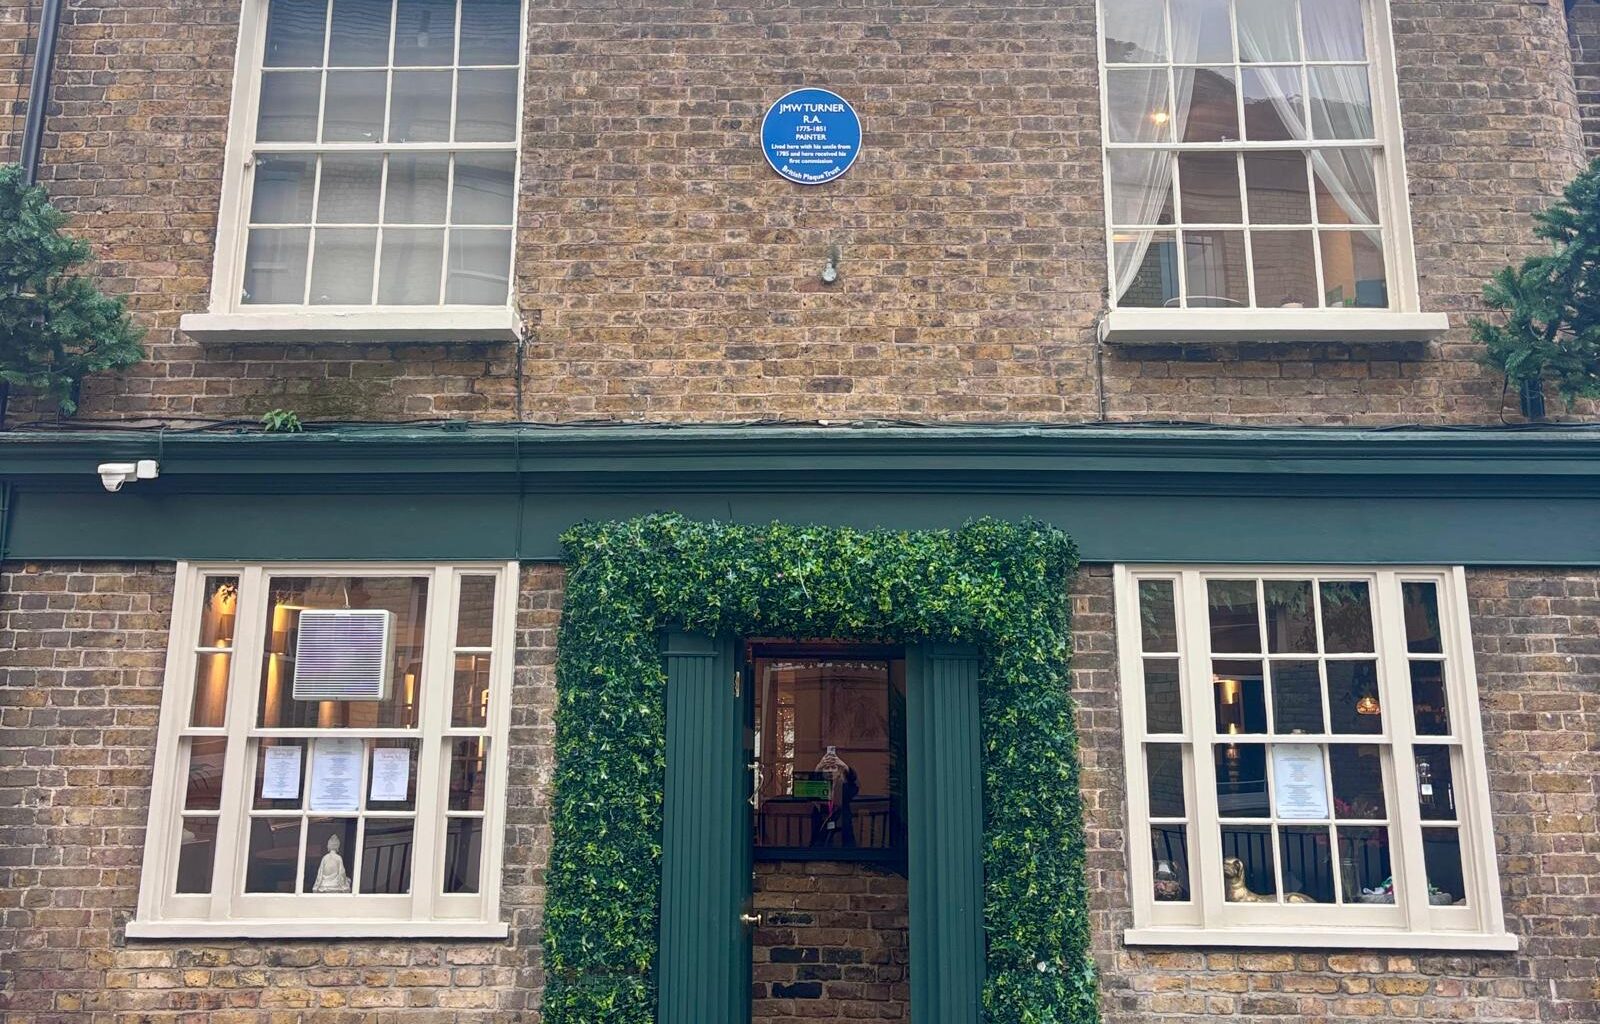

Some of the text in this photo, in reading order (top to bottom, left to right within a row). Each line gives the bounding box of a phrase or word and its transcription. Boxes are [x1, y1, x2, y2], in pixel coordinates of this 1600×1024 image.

[779, 103, 845, 114] JMW TURNER
[803, 115, 822, 124] R.A.
[782, 164, 841, 182] British Plaque Trust
